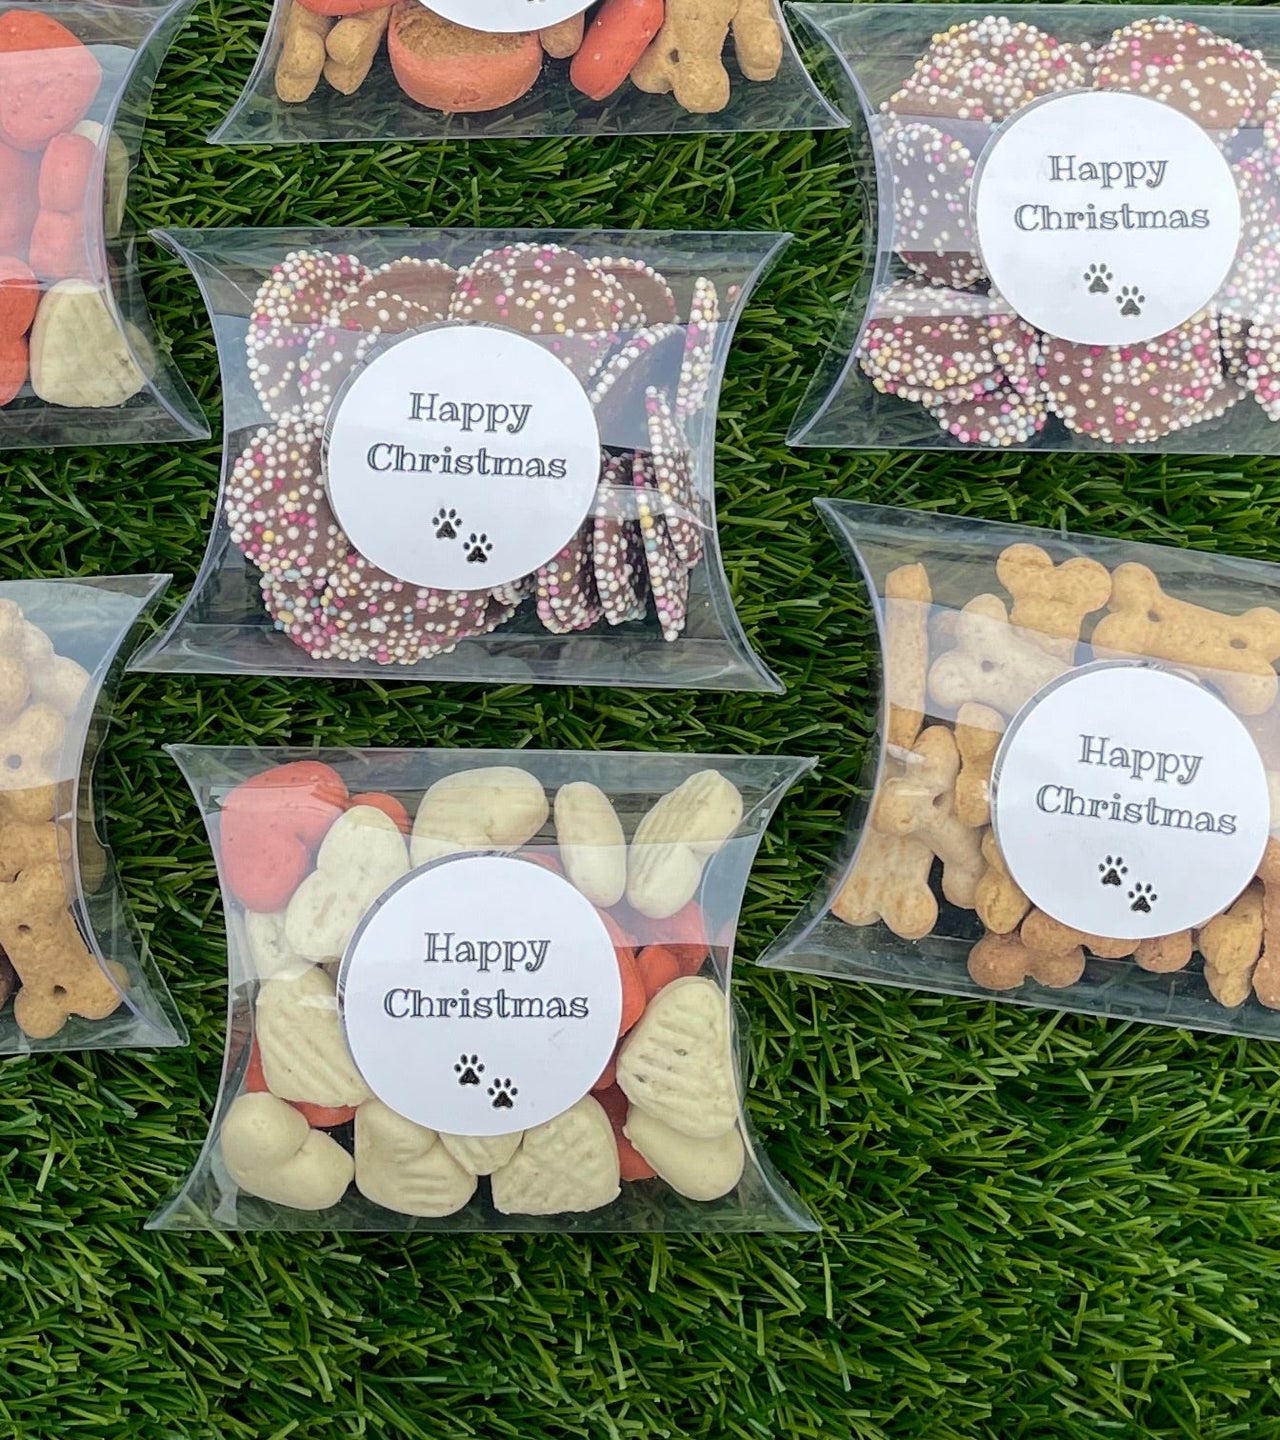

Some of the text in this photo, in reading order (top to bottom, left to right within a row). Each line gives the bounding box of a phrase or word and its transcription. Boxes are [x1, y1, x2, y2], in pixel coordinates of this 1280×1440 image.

[1048, 154, 1168, 188] Happy
[1013, 202, 1210, 231] Christmas
[408, 391, 533, 434] Happy
[366, 441, 567, 479] Christmas
[1079, 733, 1202, 785] Happy
[1035, 783, 1236, 835] Christmas
[423, 931, 551, 973] Happy
[382, 987, 589, 1020] Christmas
